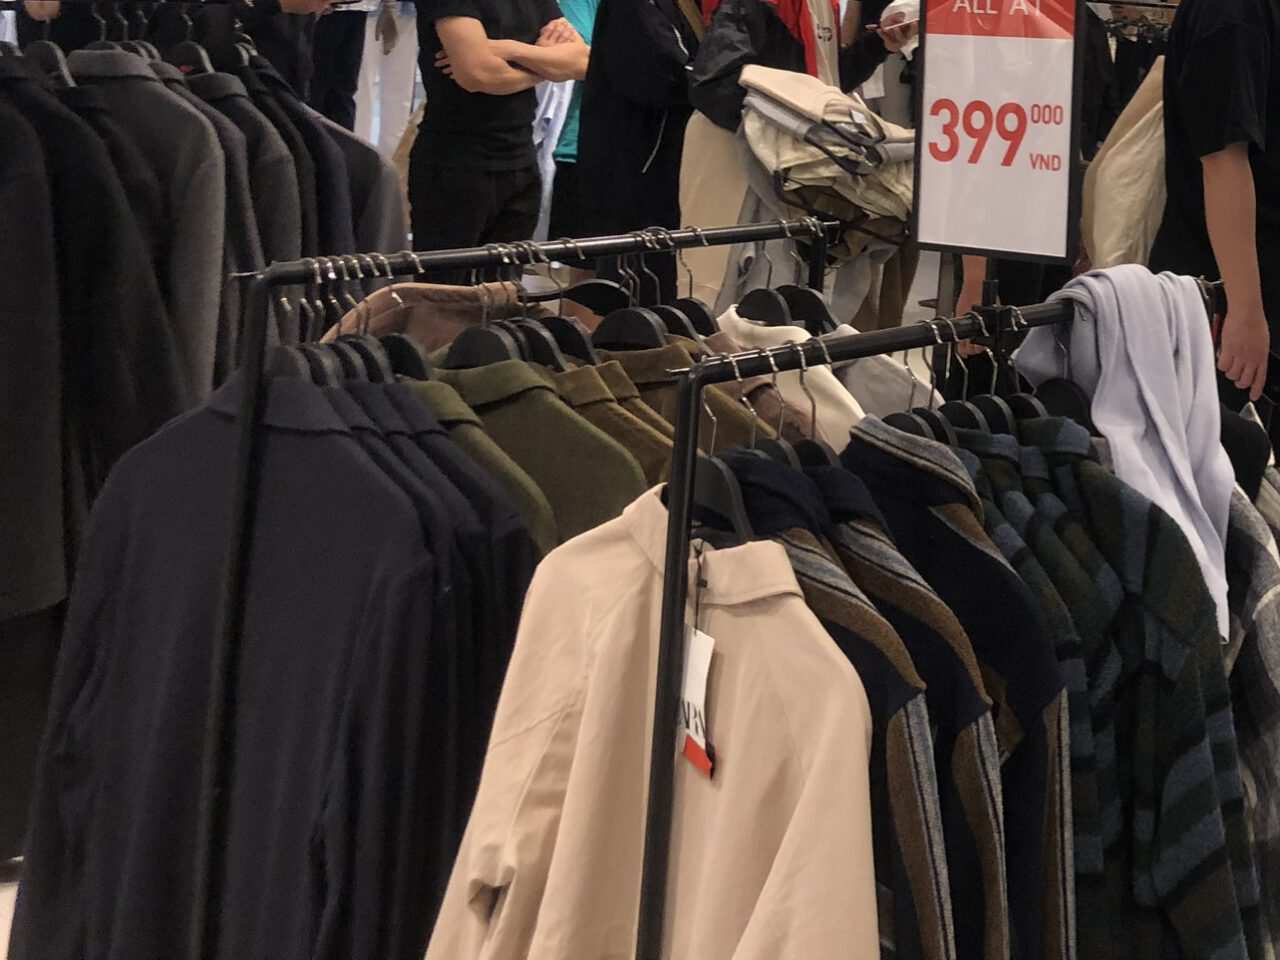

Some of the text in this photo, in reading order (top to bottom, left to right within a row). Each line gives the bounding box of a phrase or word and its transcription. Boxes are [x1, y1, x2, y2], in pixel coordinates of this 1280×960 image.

[928, 98, 1064, 167] 399 000
[1029, 153, 1062, 172] VND
